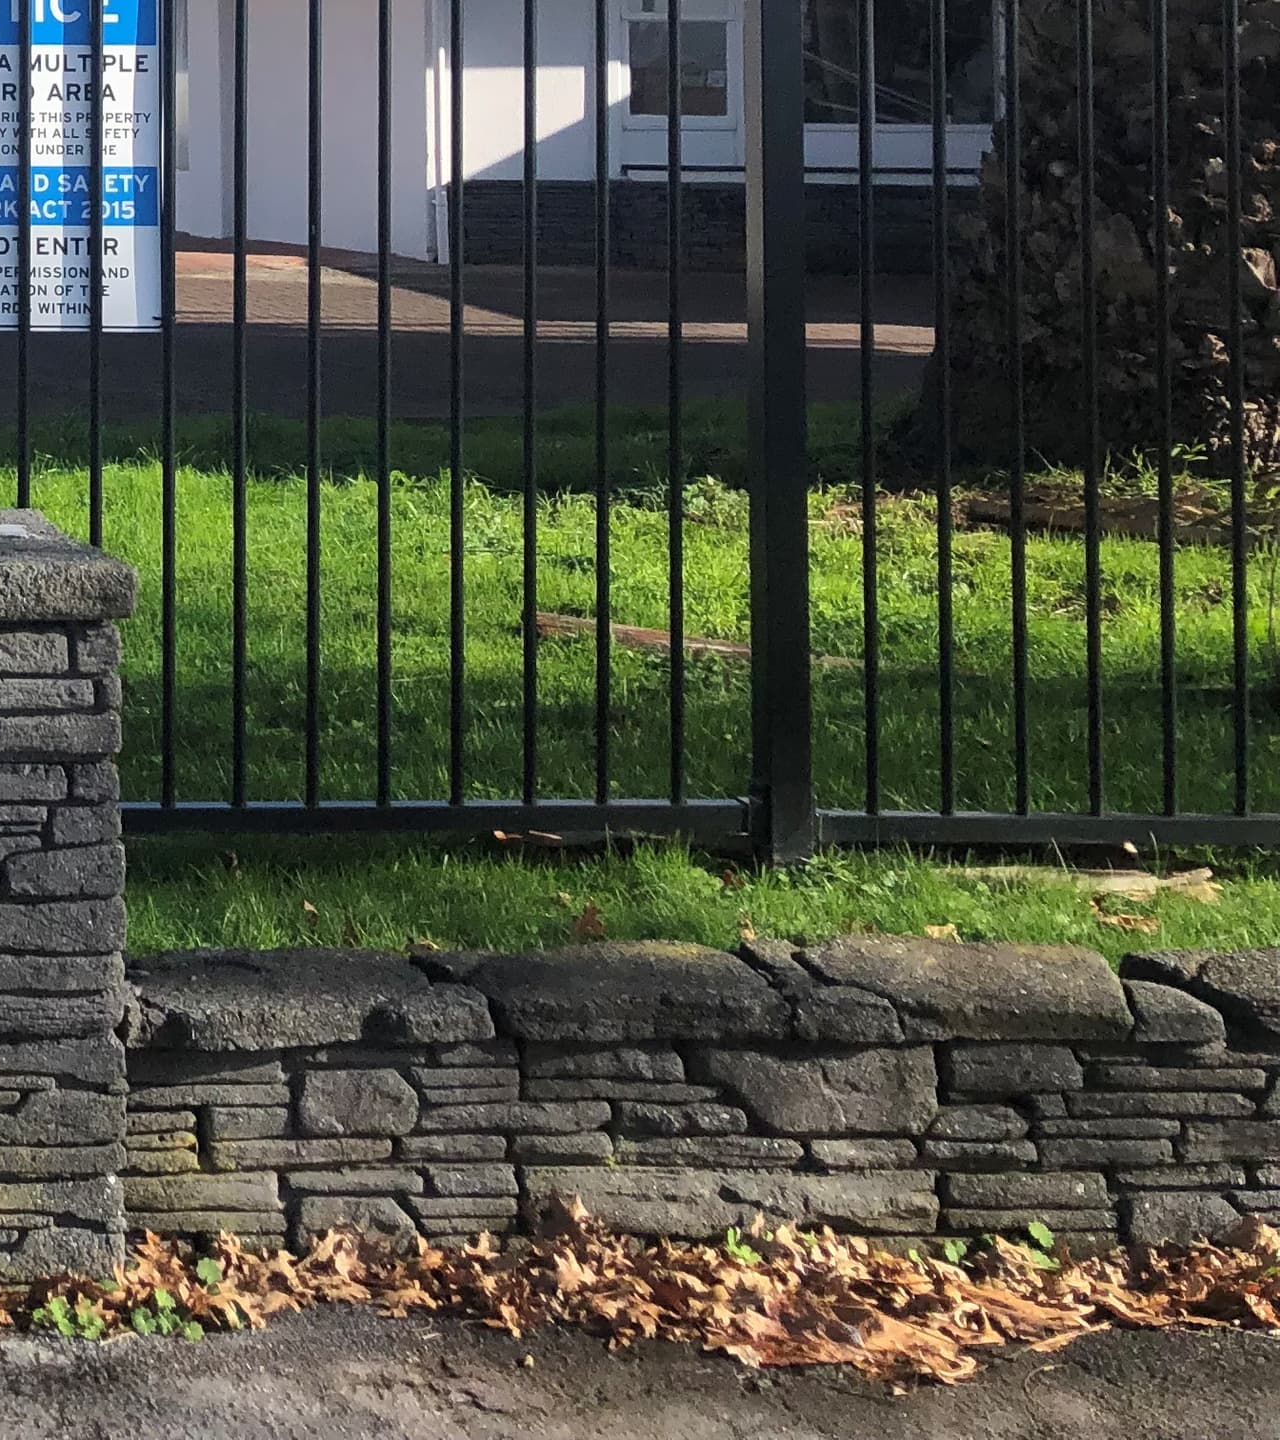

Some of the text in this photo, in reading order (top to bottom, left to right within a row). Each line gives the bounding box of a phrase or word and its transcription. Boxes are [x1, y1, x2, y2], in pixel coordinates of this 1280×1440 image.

[26, 54, 149, 72] MULTPLE
[39, 112, 72, 123] THIS
[76, 112, 151, 123] PRPERTY
[12, 128, 46, 139] WTH
[52, 128, 79, 139] ALL
[85, 128, 140, 139] SFETY
[35, 144, 84, 155] UNDER
[0, 174, 49, 192] AD
[58, 174, 150, 193] SAETY
[27, 200, 72, 219] ACT
[82, 200, 136, 220] 2015
[36, 237, 119, 256] ENTR
[54, 285, 74, 297] OF
[80, 285, 110, 297] TE
[38, 302, 92, 315] WITHIN
